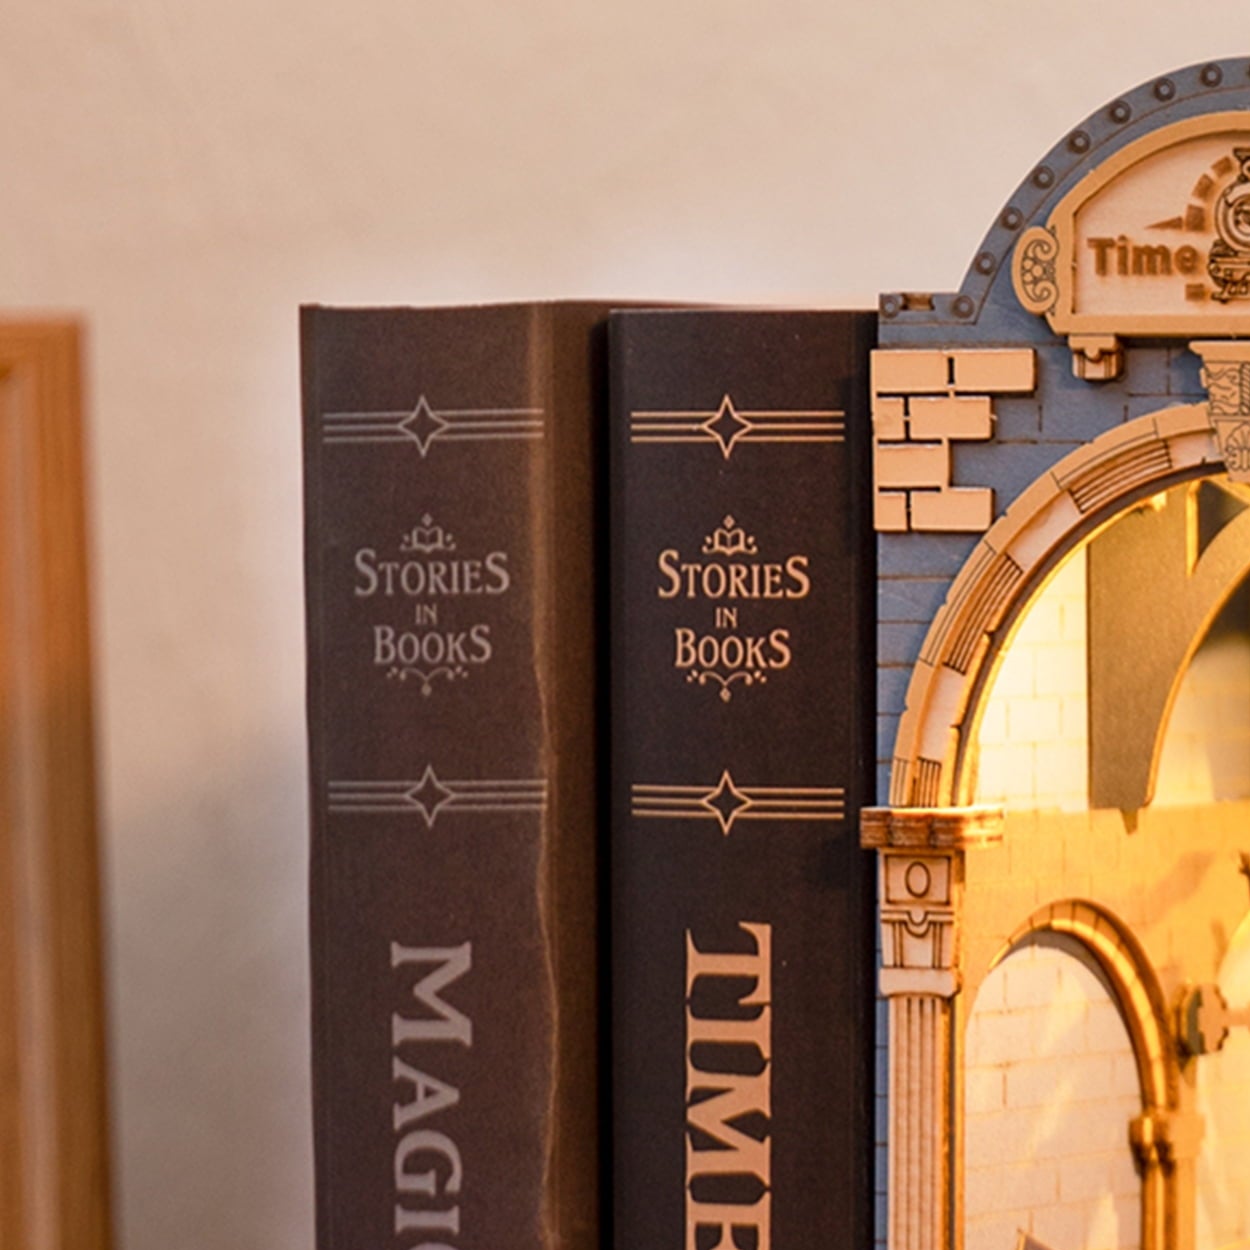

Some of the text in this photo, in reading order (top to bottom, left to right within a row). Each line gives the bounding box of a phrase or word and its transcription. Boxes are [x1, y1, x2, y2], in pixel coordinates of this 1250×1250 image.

[1087, 234, 1200, 277] Time
[354, 546, 510, 596] STORIES
[658, 548, 811, 600] STORIES
[415, 603, 438, 627] IN
[715, 607, 738, 629] IN
[374, 624, 493, 665] BOOKS
[675, 628, 792, 669] BOOKS
